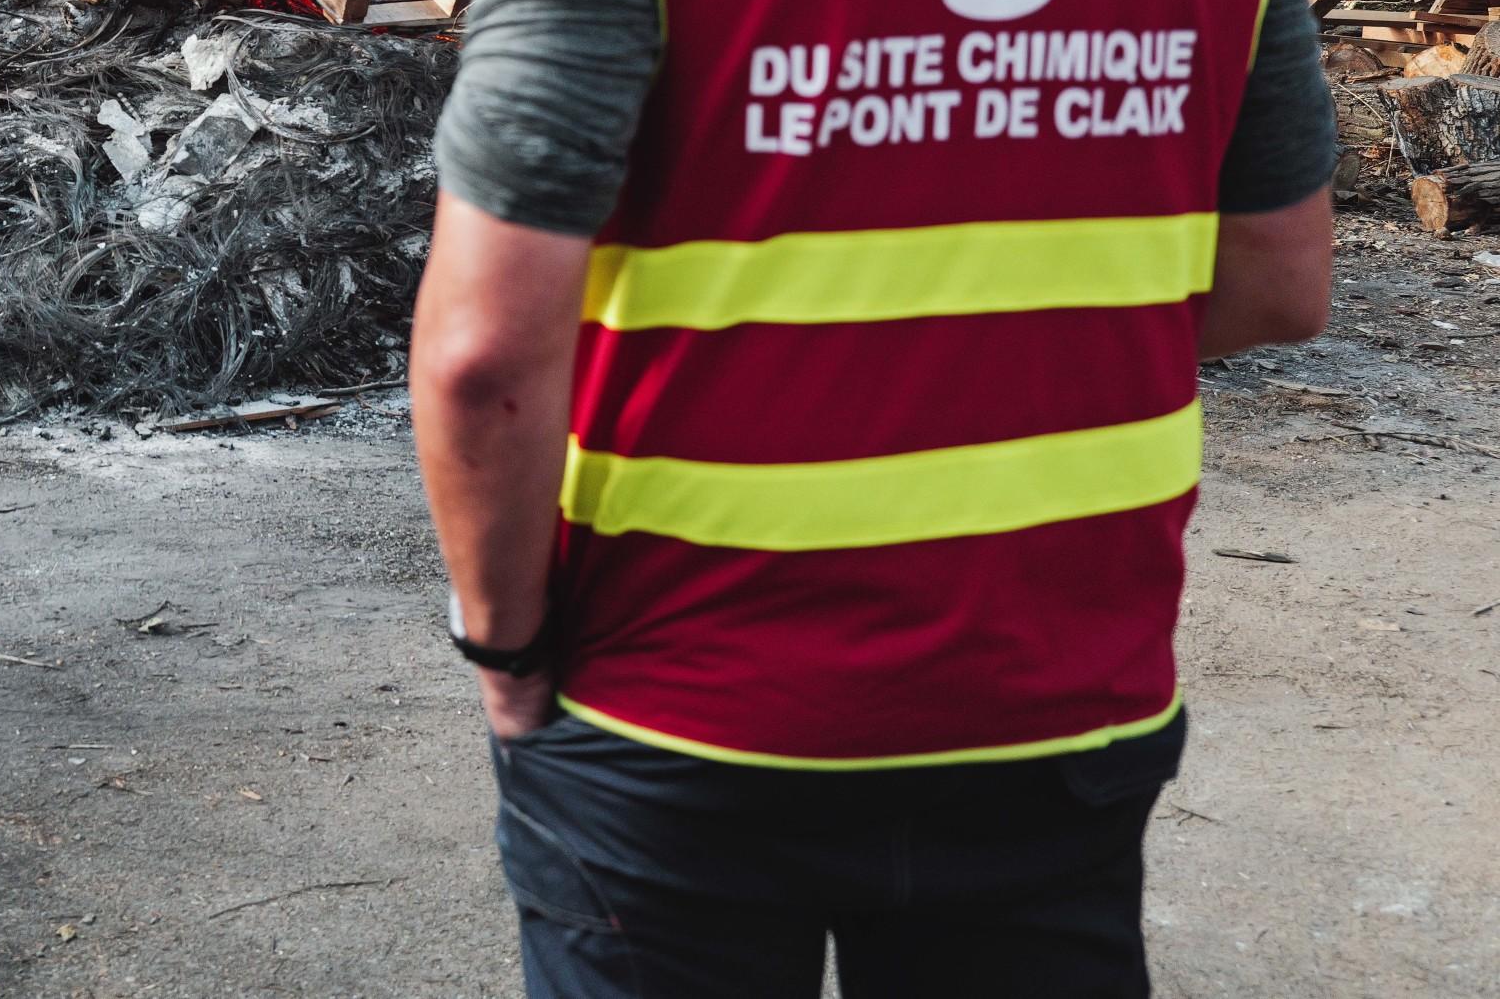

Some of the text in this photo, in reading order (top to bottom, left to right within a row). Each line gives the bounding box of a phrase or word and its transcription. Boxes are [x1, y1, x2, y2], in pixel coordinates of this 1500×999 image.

[749, 29, 1197, 96] DU SITE CHIMIQUE
[745, 84, 1190, 155] LE PONT DE CLAIX
